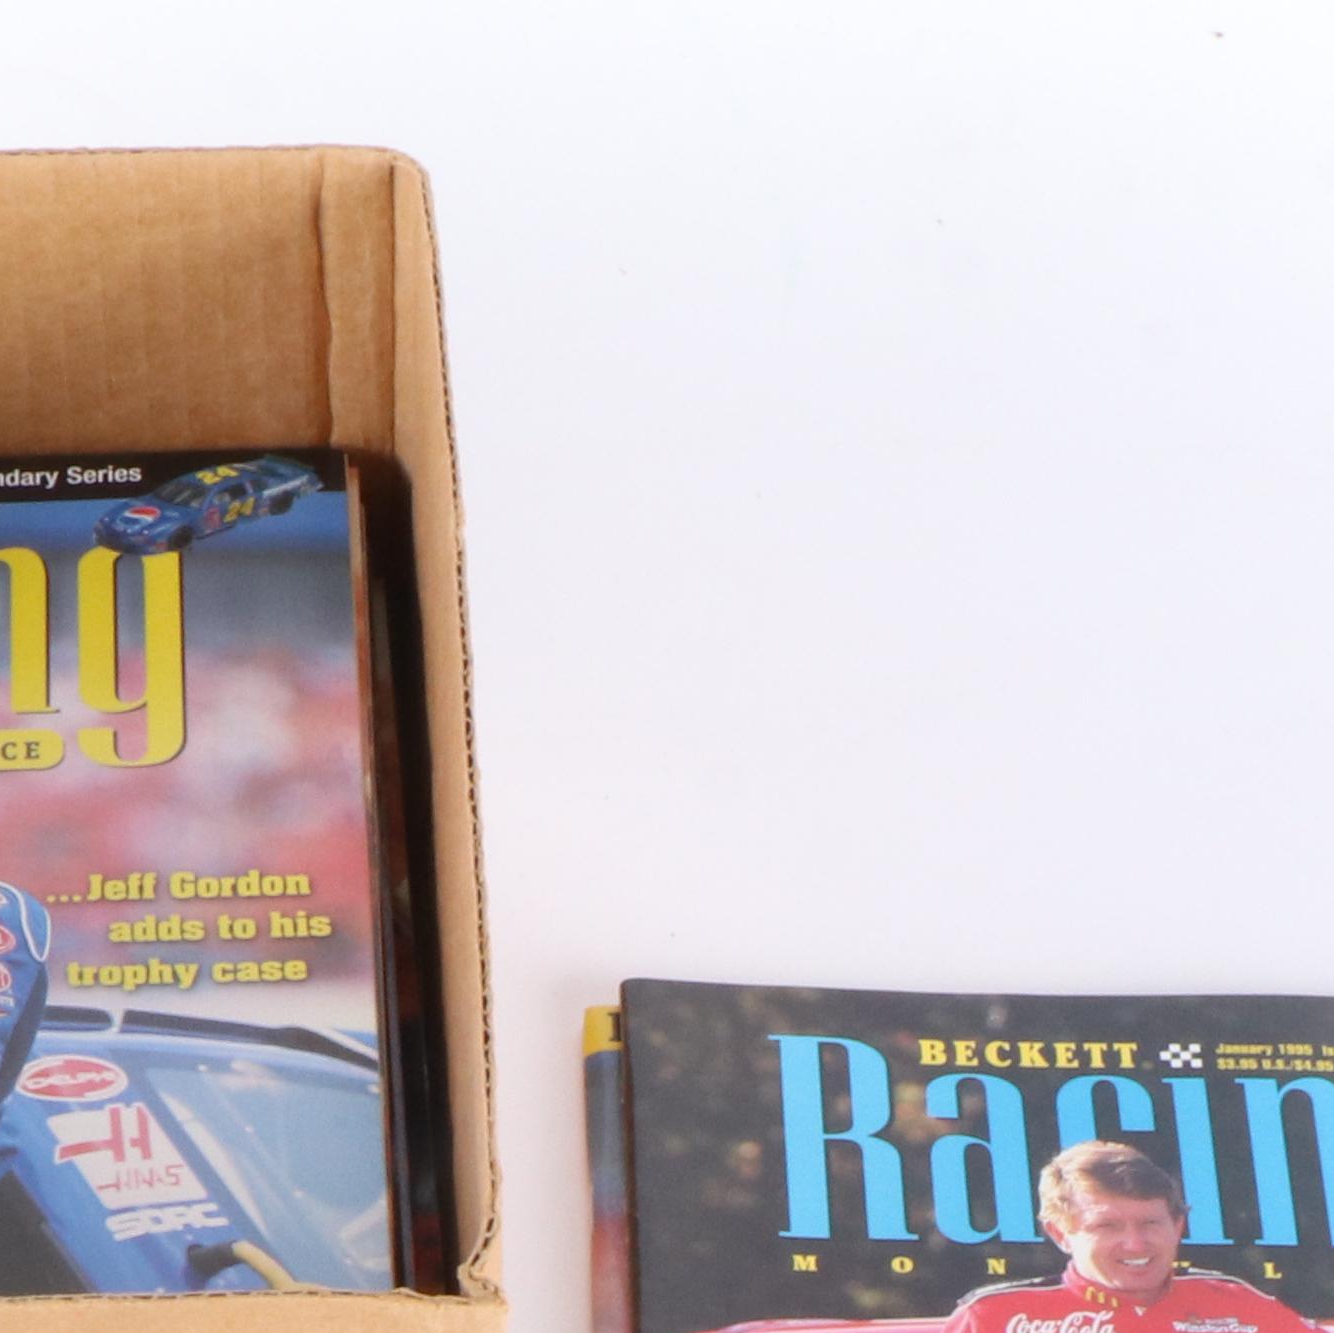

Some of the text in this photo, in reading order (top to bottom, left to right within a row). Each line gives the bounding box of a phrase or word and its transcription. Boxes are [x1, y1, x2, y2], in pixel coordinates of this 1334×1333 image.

[67, 464, 142, 485] Series
[170, 869, 311, 899] Gordon
[108, 911, 332, 943] adds to his
[68, 958, 308, 990] trophy case
[918, 1039, 1137, 1068] BECKETT
[1215, 1043, 1273, 1056] January
